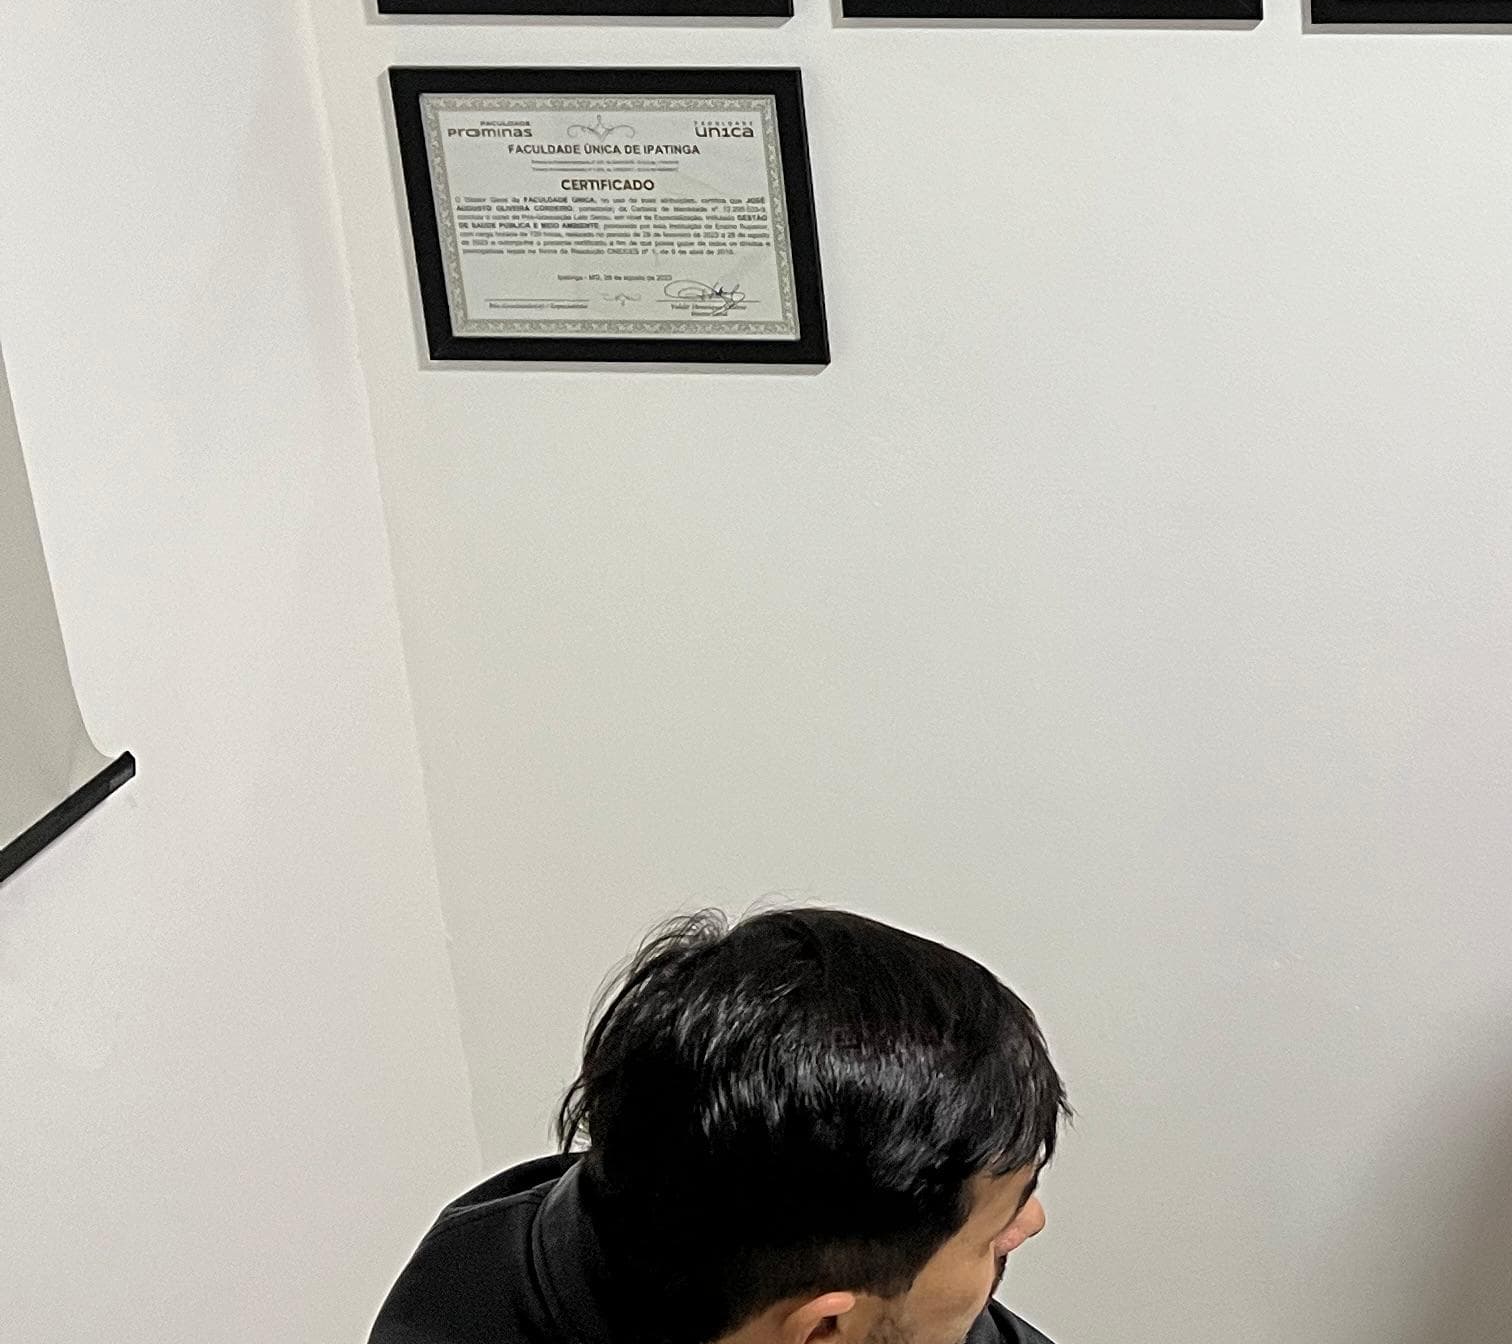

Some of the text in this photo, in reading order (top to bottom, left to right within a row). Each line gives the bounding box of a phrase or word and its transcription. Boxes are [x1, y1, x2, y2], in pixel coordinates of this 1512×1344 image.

[448, 129, 532, 137] prominas
[508, 143, 700, 154] FACULDADE ÚNICA DE IPATINGA
[562, 179, 654, 190] CERTIFICADO
